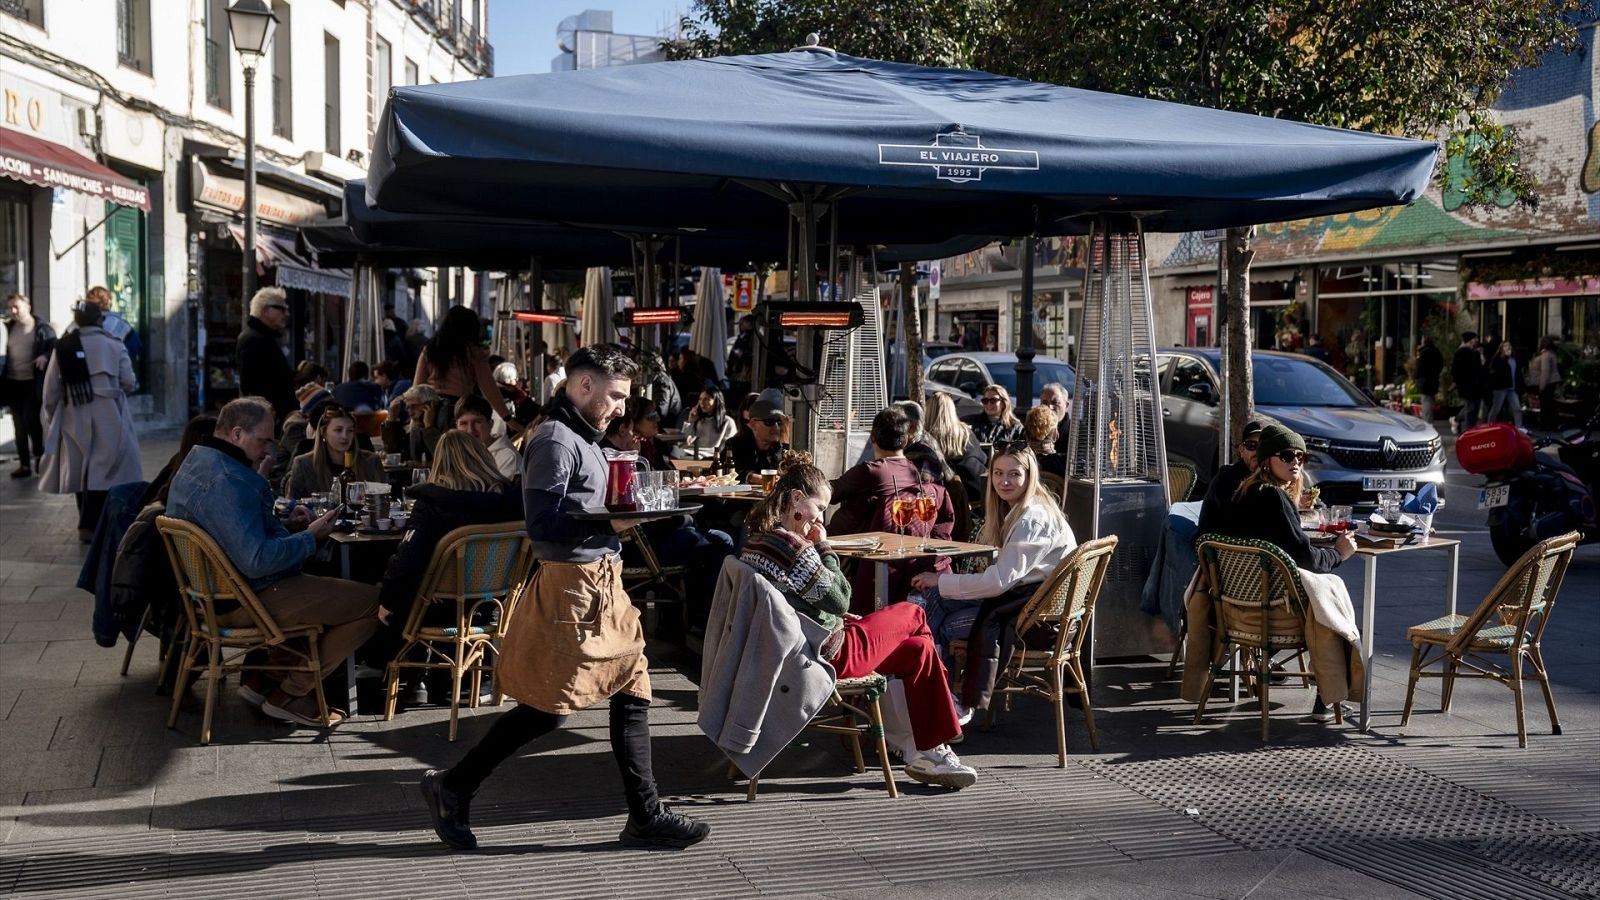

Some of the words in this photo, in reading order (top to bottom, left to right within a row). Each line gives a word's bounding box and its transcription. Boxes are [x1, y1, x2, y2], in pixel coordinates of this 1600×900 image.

[919, 151, 938, 161] EL
[941, 152, 1000, 163] VIAJERO
[947, 168, 972, 177] 1995
[43, 167, 104, 195] SANDWICHES
[111, 184, 147, 204] BEBIDAS
[1190, 290, 1212, 302] Cajero
[1371, 478, 1393, 490] 1851
